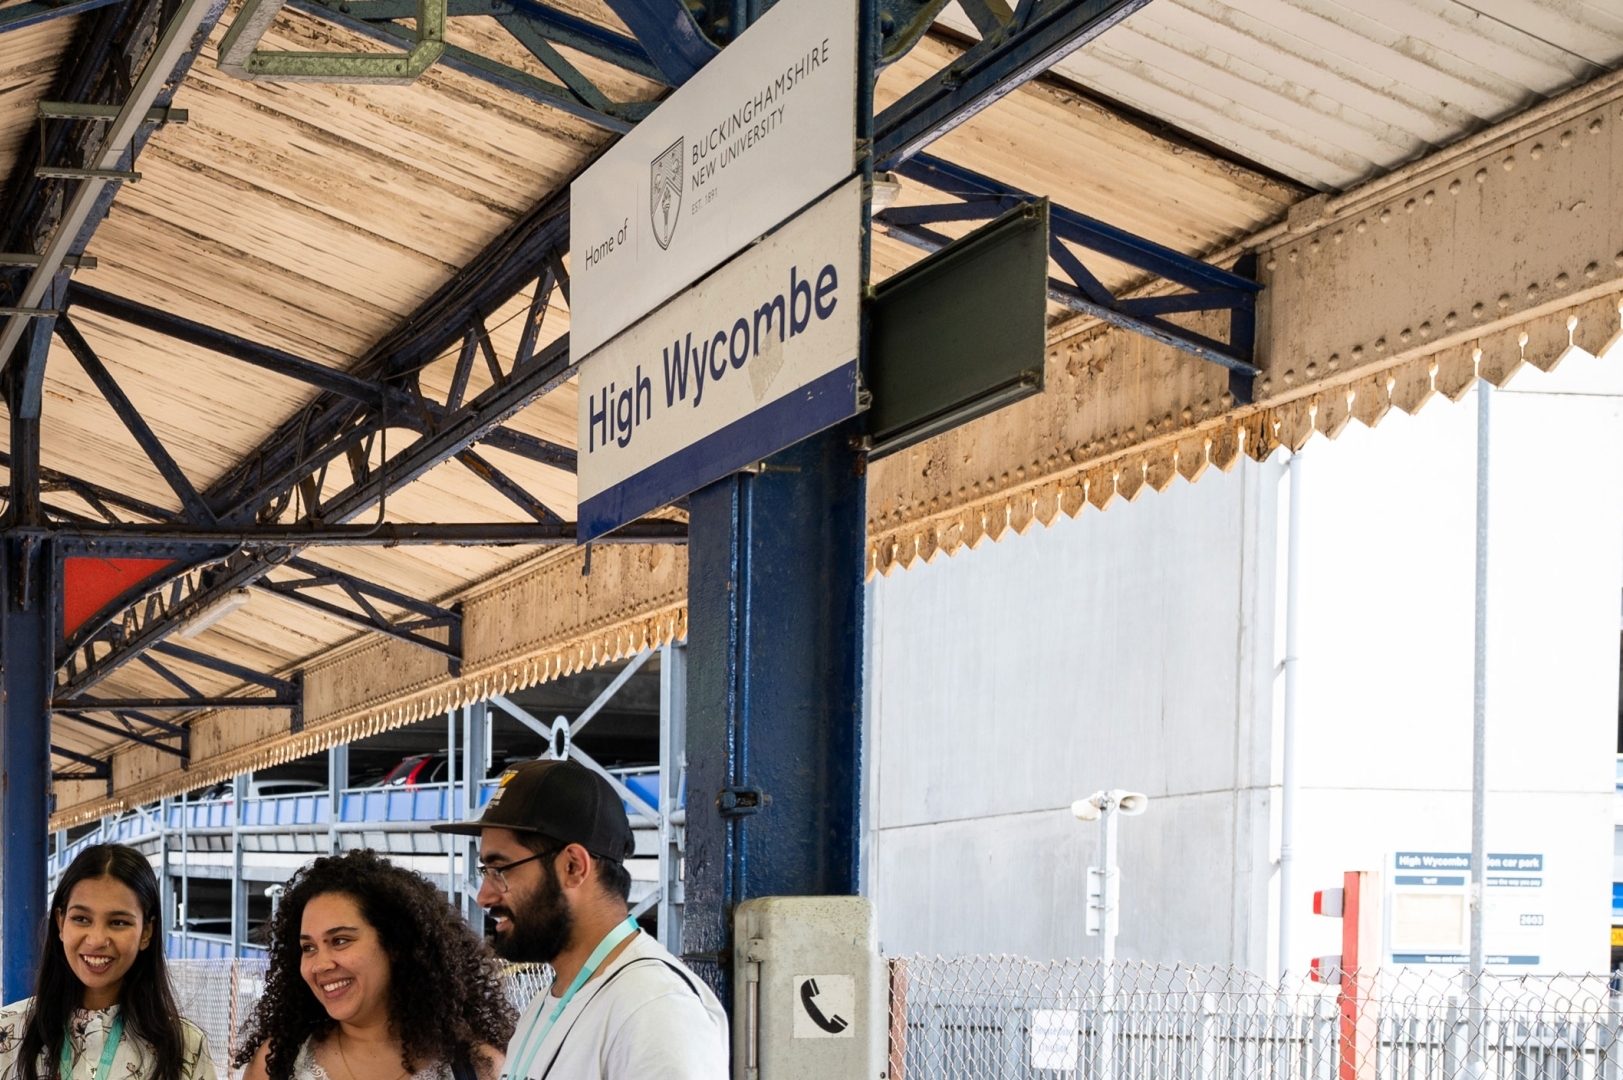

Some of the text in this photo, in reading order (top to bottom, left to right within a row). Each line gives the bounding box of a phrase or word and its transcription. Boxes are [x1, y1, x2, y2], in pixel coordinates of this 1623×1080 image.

[691, 37, 830, 166] BUCKINGHAMSHIRE
[691, 104, 785, 191] NEW UNIVERSITY
[585, 218, 628, 271] Home of
[589, 264, 838, 454] High Wycombe
[1399, 855, 1421, 867] High
[1422, 855, 1468, 868] Wycombe
[1502, 859, 1517, 867] car
[1518, 857, 1539, 869] park
